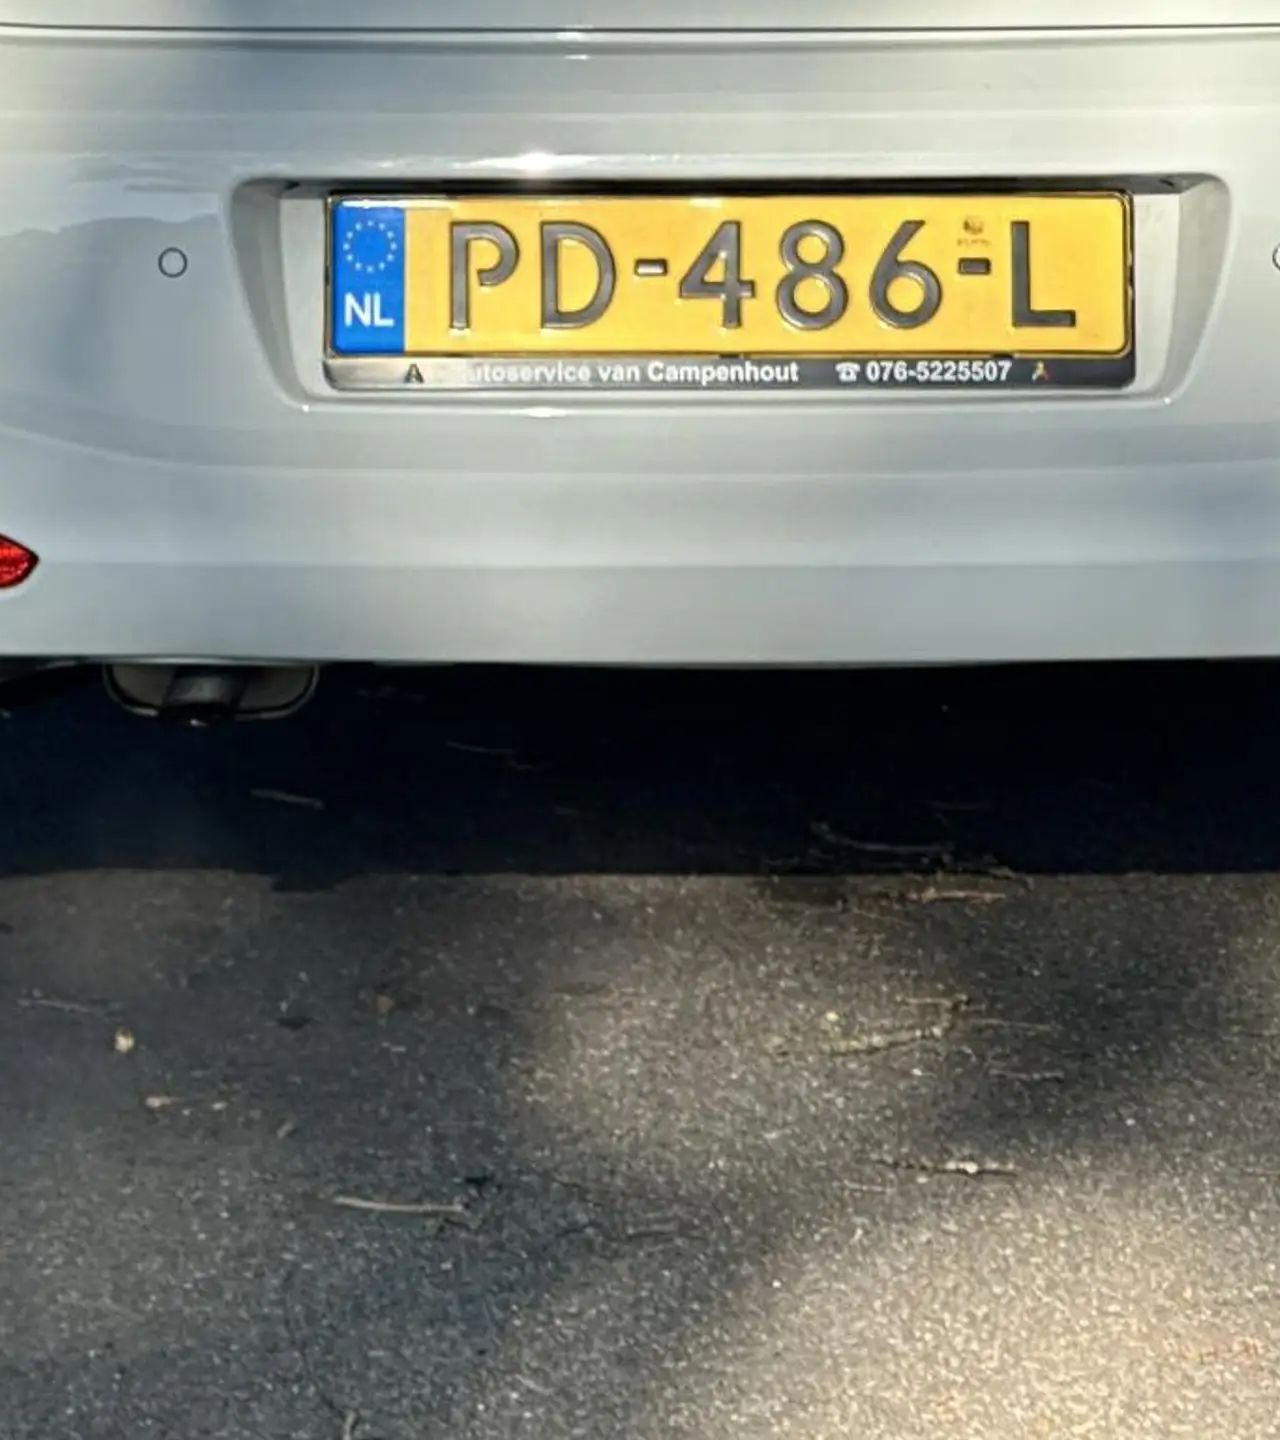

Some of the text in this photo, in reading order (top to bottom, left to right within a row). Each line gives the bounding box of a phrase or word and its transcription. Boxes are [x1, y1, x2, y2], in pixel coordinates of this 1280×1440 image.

[449, 219, 1077, 331] PD-486-L
[344, 292, 396, 327] NL
[454, 361, 591, 382] utoservice
[597, 364, 641, 382] van
[646, 361, 800, 387] Campenhout
[865, 360, 1012, 382] 076-5225507
